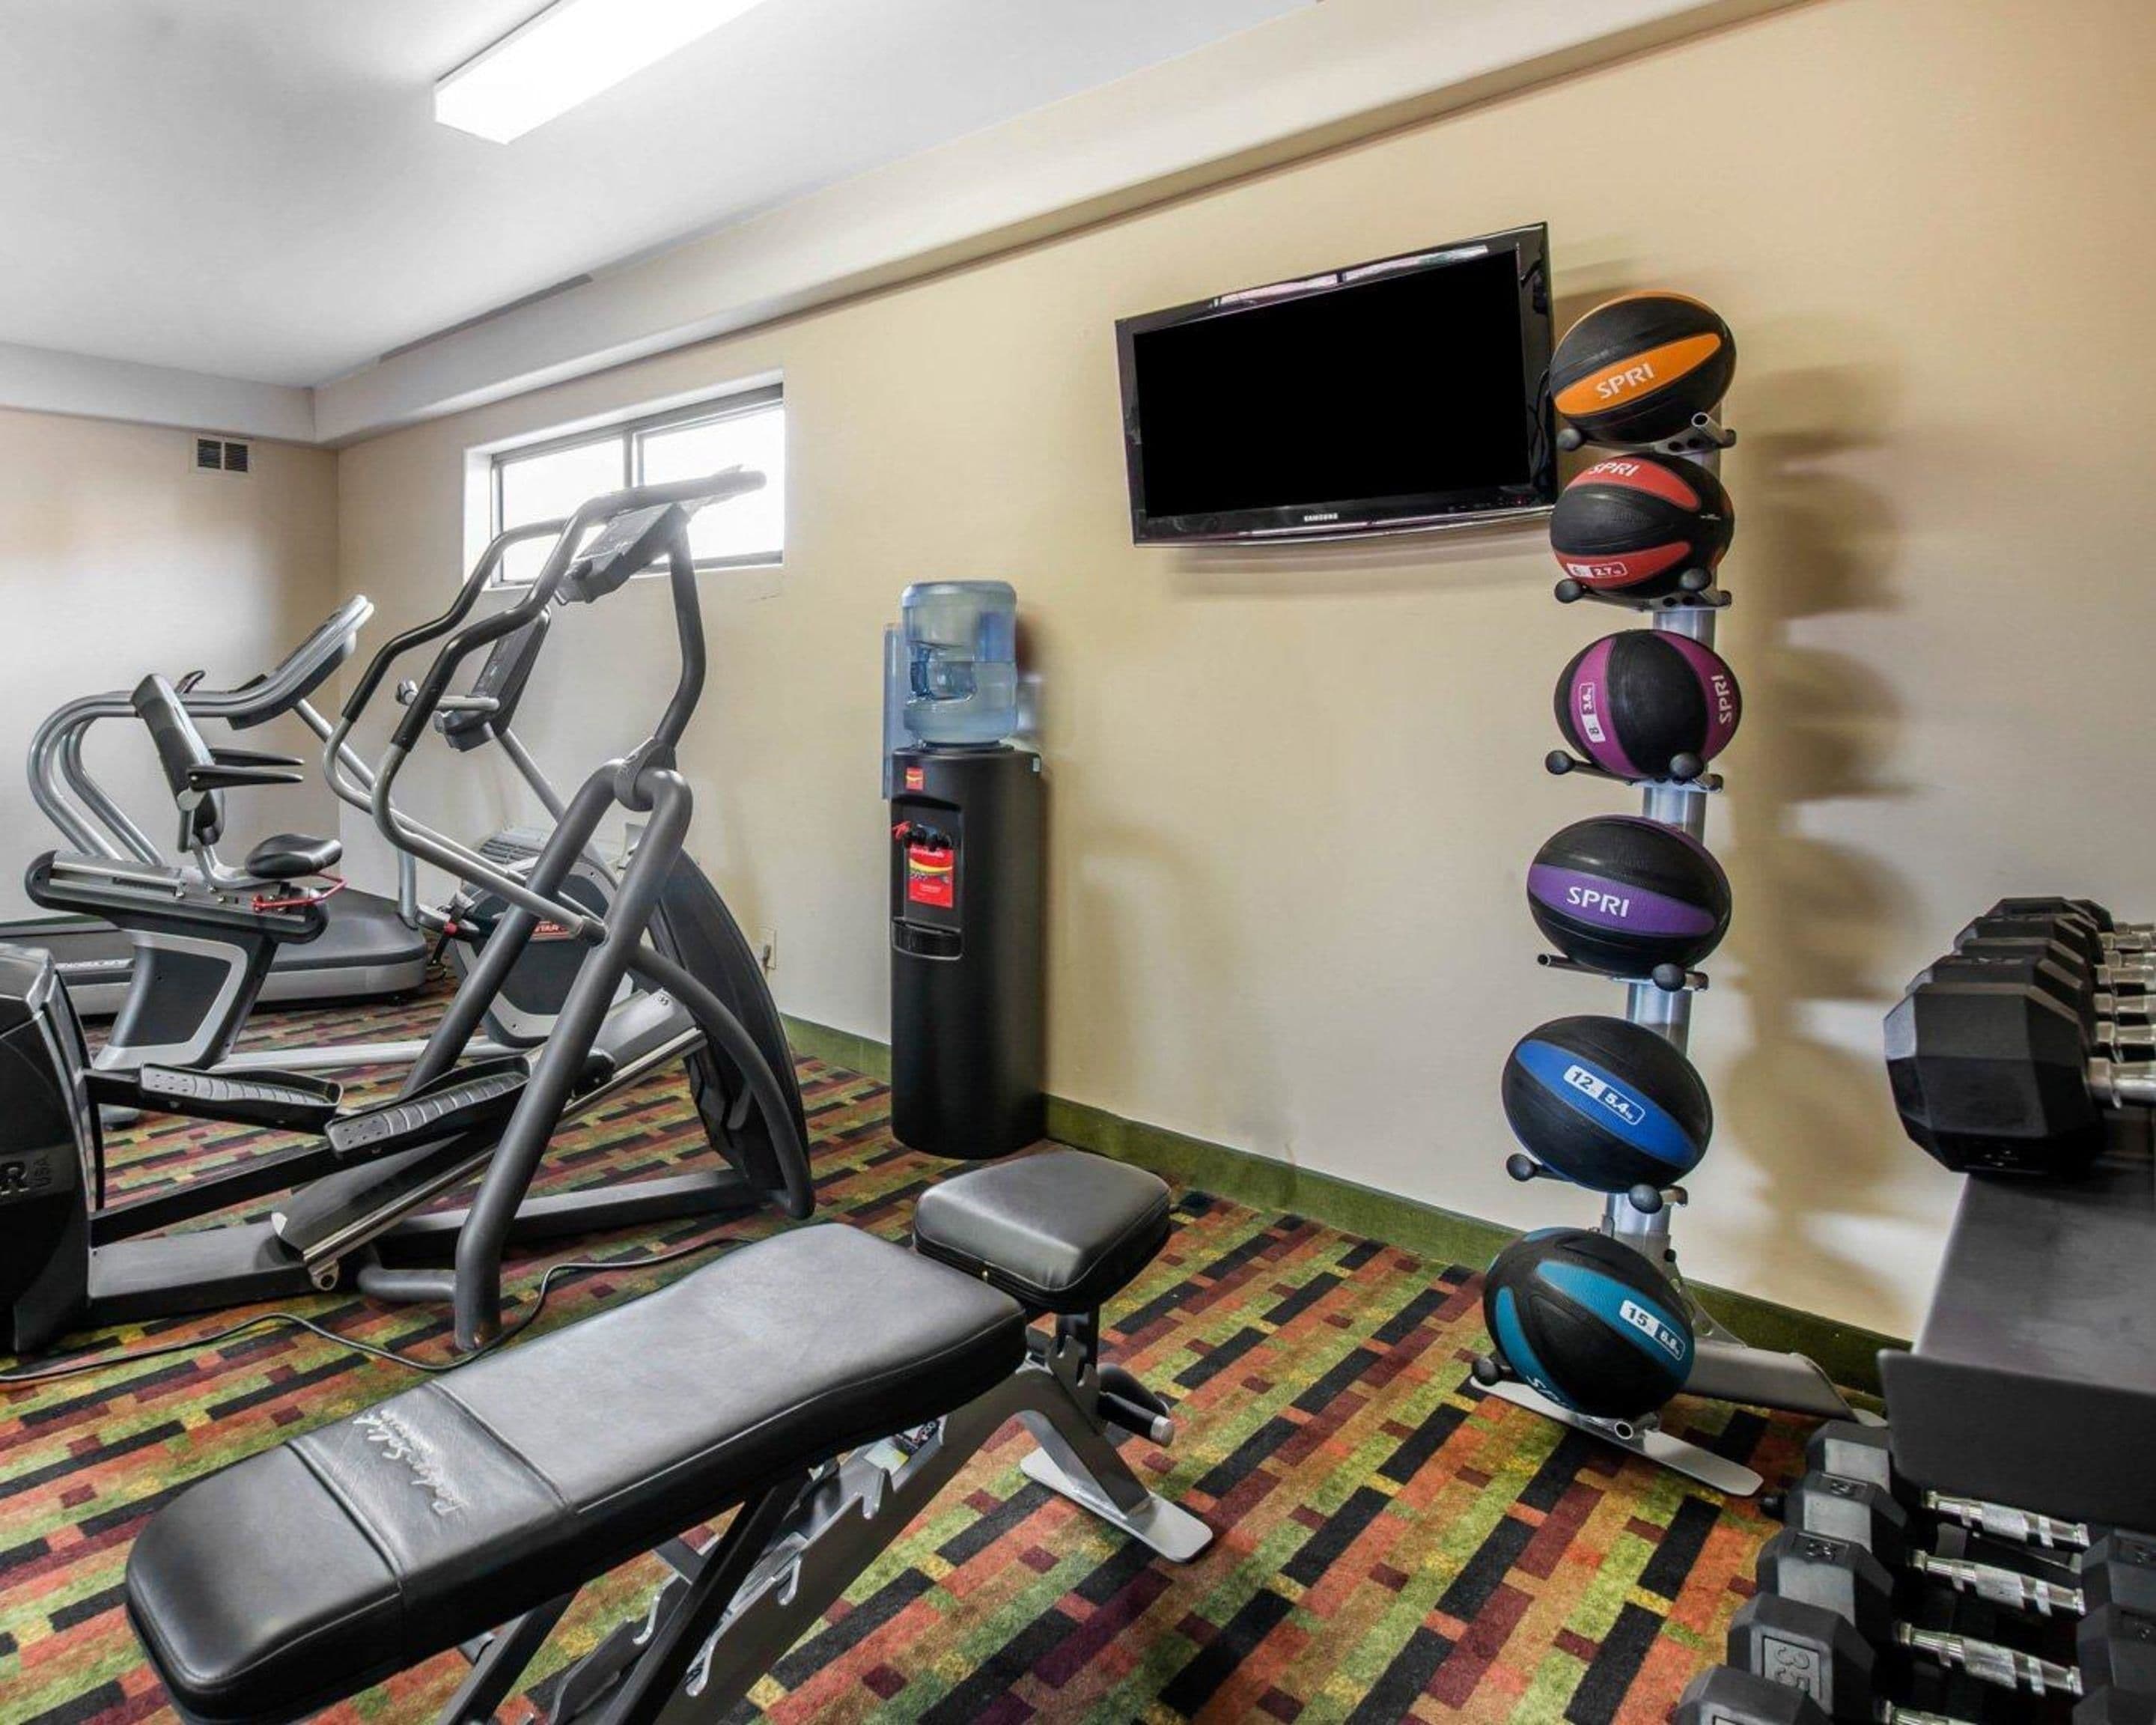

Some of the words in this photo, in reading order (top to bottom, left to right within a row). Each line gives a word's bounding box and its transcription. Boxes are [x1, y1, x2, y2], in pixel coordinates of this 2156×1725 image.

[1595, 362, 1655, 399] SPRI
[1588, 461, 1641, 478] SPRI
[1711, 675, 1732, 725] SPRI
[1566, 886, 1630, 918] SPRI
[1572, 1070, 1595, 1091] 12
[1604, 1092, 1630, 1115] 5.4
[1628, 1306, 1648, 1327] 15
